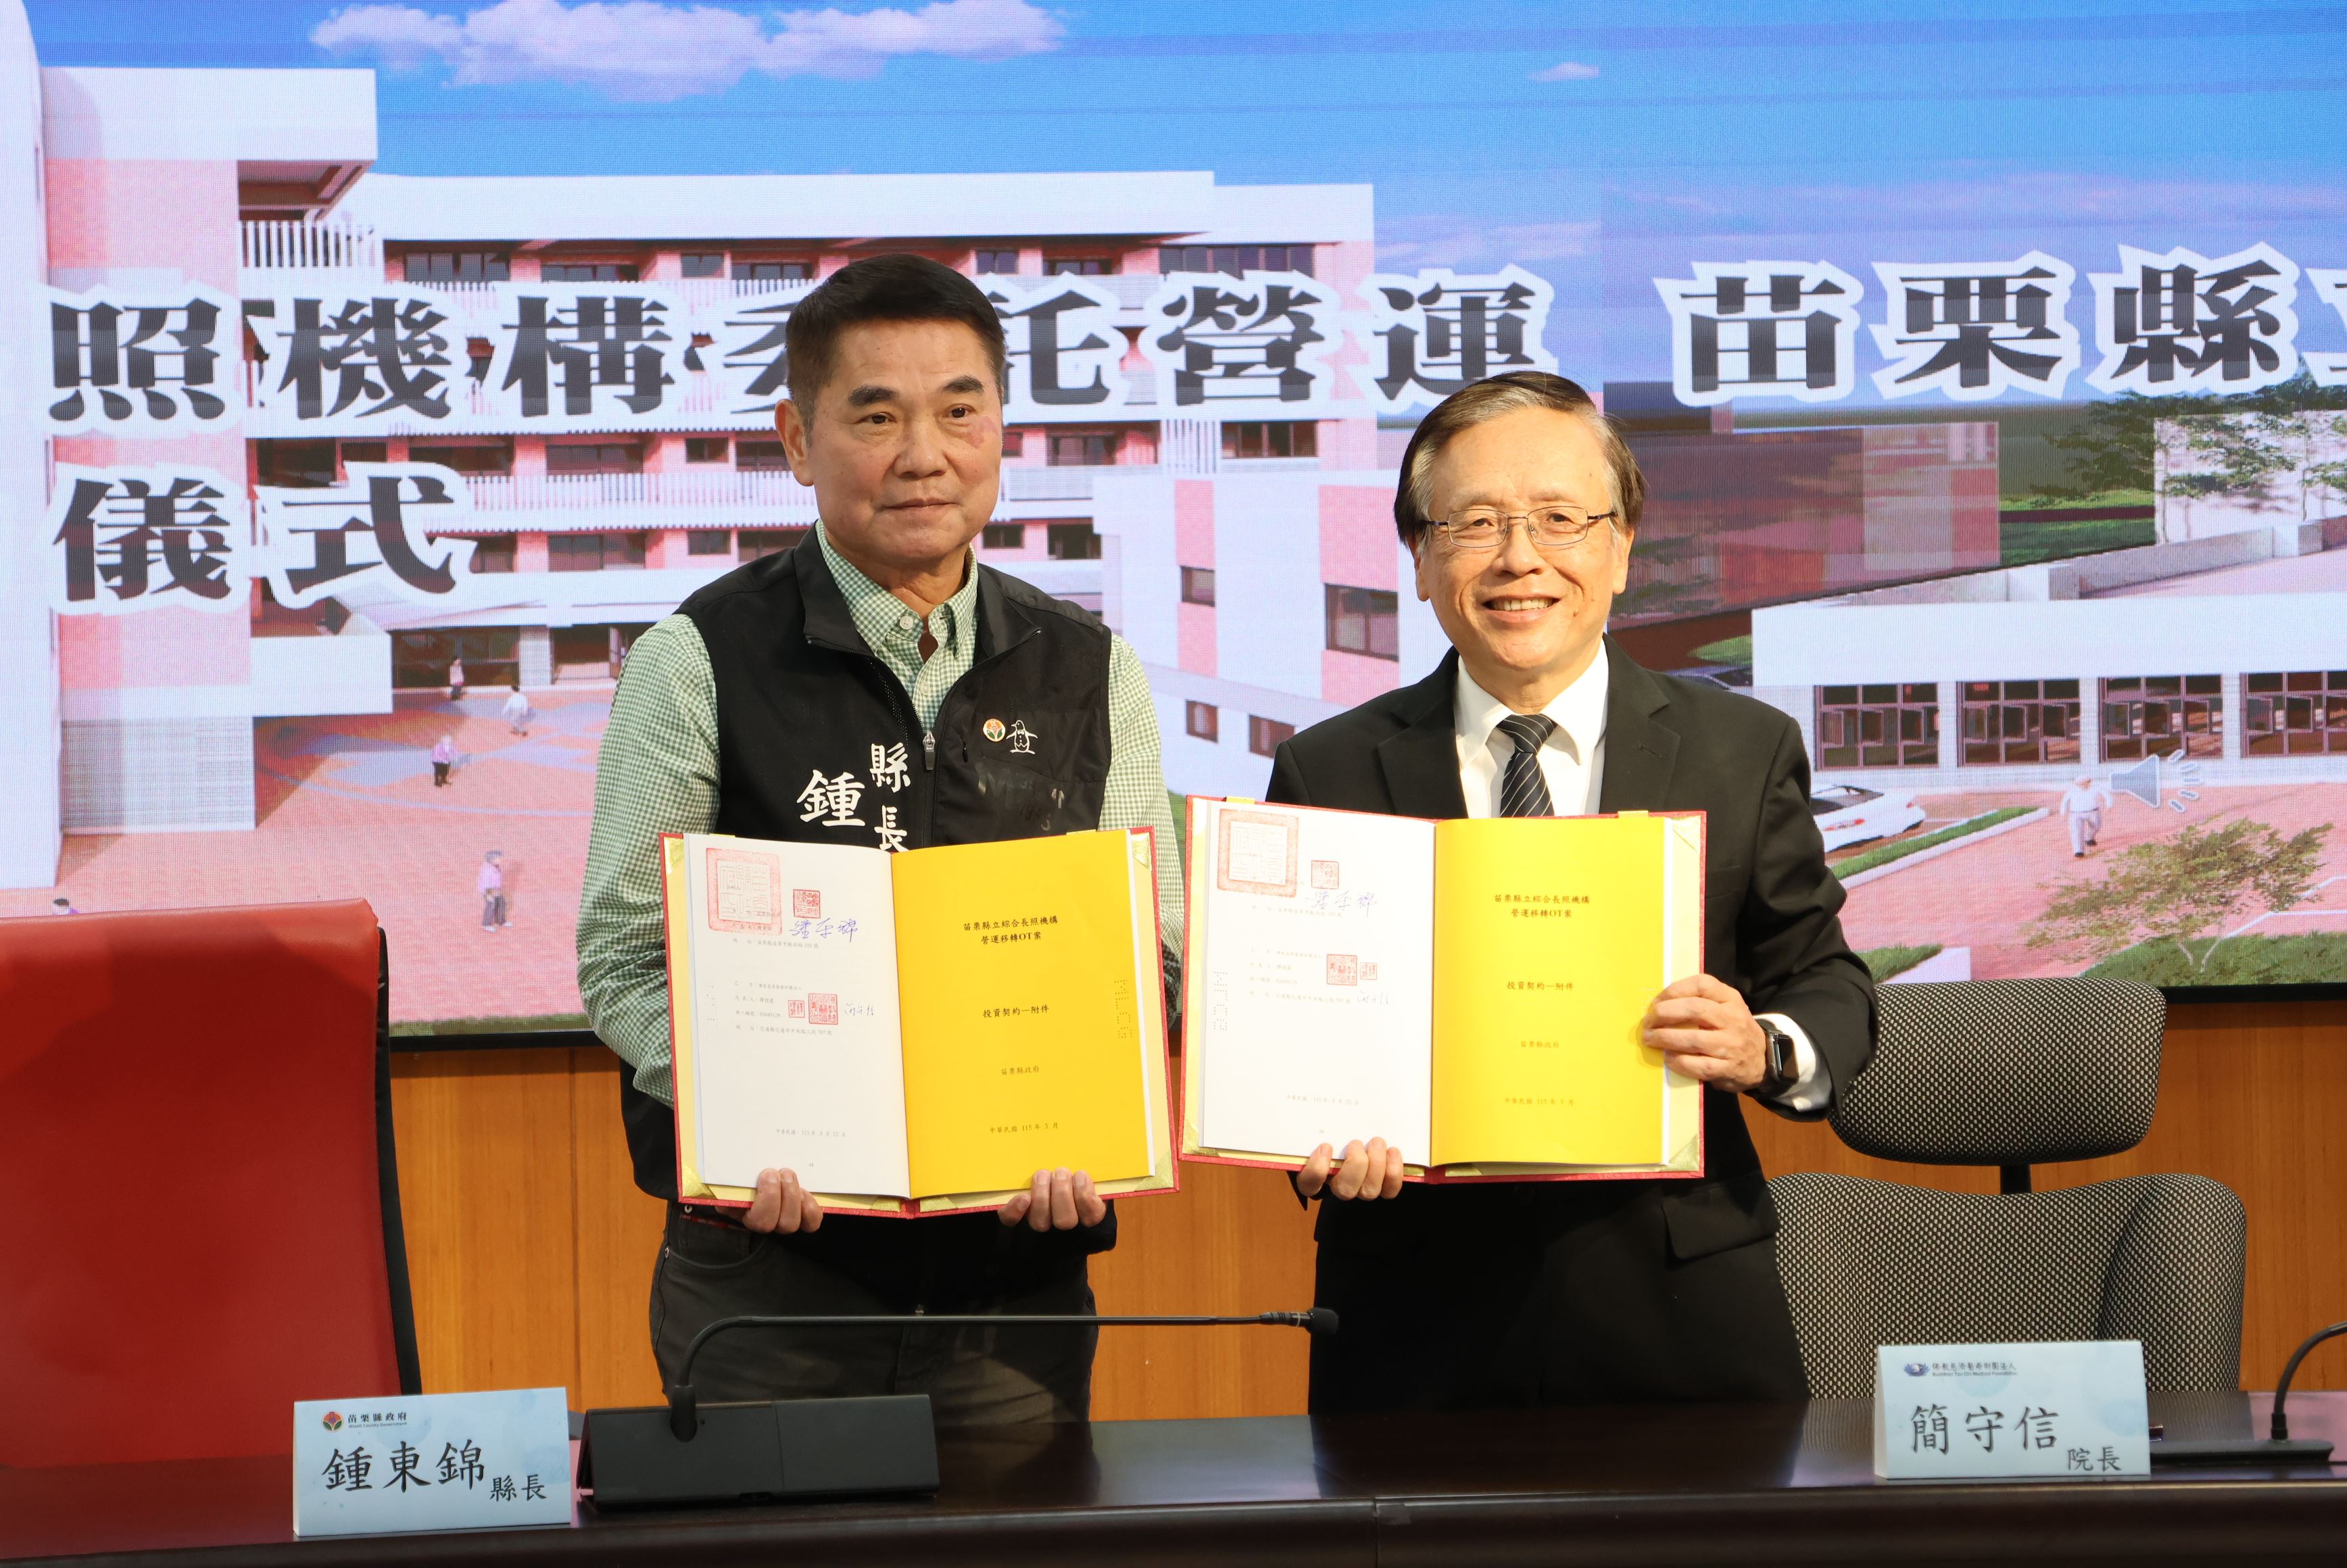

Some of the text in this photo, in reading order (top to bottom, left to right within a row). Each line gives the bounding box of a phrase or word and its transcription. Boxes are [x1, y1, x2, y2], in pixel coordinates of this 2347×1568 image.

[1679, 260, 2347, 392] 苗栗縣
[53, 475, 458, 602] 儀式
[796, 769, 865, 827] 鍾
[869, 742, 911, 852] 縣長
[1495, 894, 1590, 904] 苗栗縣立綜合長照機構
[1511, 908, 1572, 918] 營運移轉OT案
[963, 915, 1059, 931] 苗栗縣立綜合長照機構
[981, 931, 1042, 945] 營運移轉OT案
[1001, 1066, 1039, 1075] 苗栗縣政府
[348, 1412, 406, 1423] 苗栗縣政府
[1910, 1403, 2122, 1472] 簡守信 院長
[321, 1439, 547, 1502] 鍾東錦 縣長
